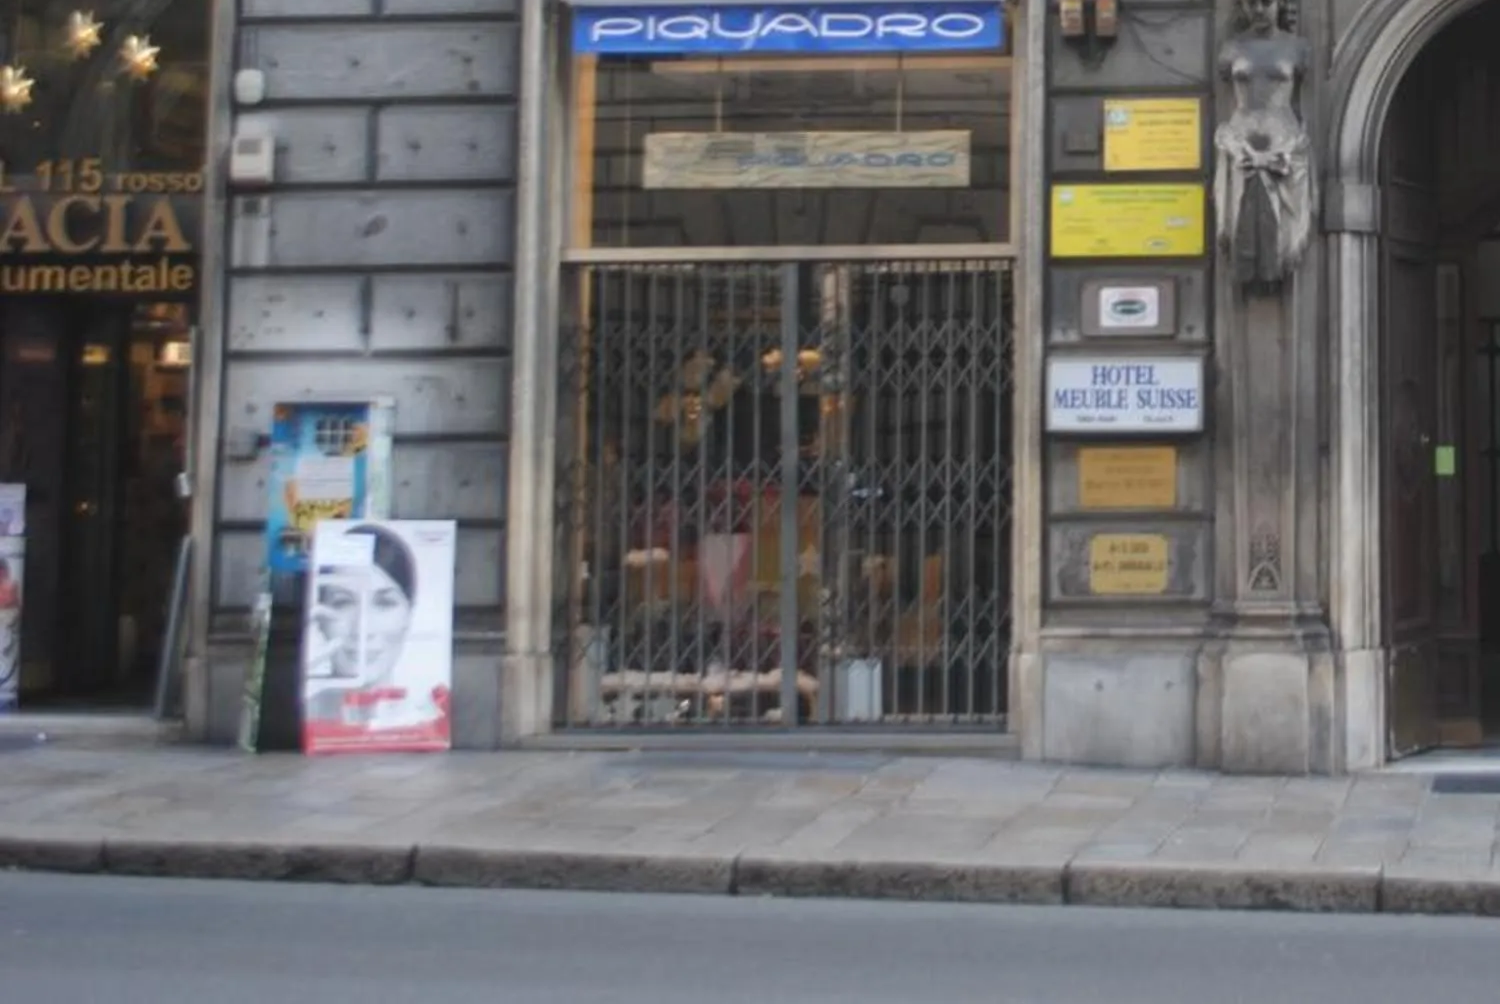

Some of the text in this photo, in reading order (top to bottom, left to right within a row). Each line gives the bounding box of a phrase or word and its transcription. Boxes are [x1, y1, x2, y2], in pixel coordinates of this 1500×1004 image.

[592, 13, 985, 51] PIQUADRO
[36, 158, 102, 192] 115
[116, 171, 204, 193] rosso
[736, 151, 957, 169] PIQUADRO
[0, 195, 192, 254] ACIA
[1, 256, 195, 291] umentale
[1091, 364, 1159, 386] HOTEL
[1136, 387, 1199, 409] SUISSE
